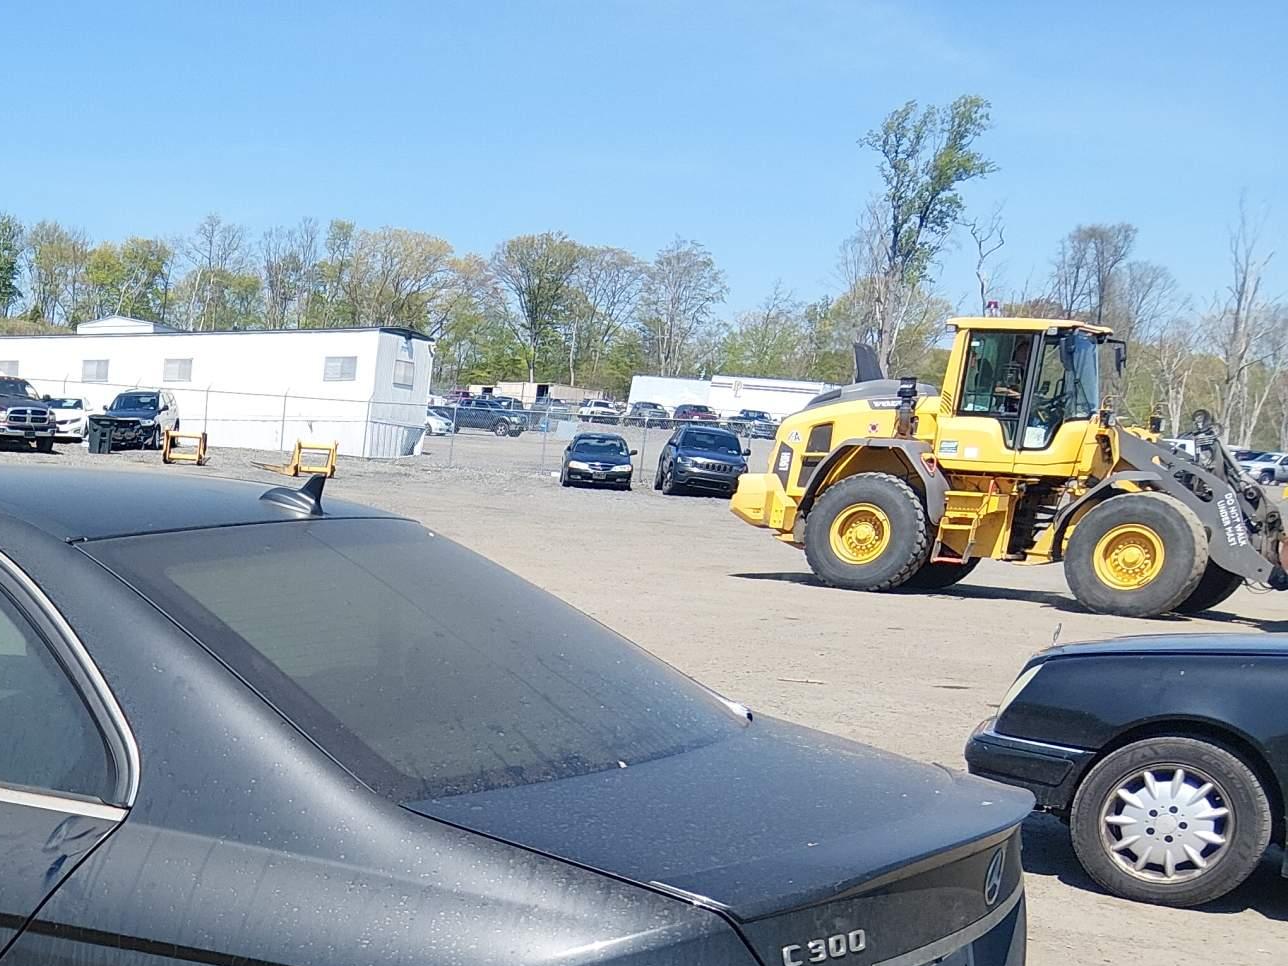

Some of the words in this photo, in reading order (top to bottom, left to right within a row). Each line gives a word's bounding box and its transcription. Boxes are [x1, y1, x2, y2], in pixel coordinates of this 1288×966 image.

[1224, 493, 1235, 506] DO
[1217, 500, 1231, 527] UNDER
[1225, 526, 1237, 546] MAST
[1228, 506, 1241, 522] NOT
[1234, 524, 1248, 547] WALK
[807, 929, 866, 963] 300
